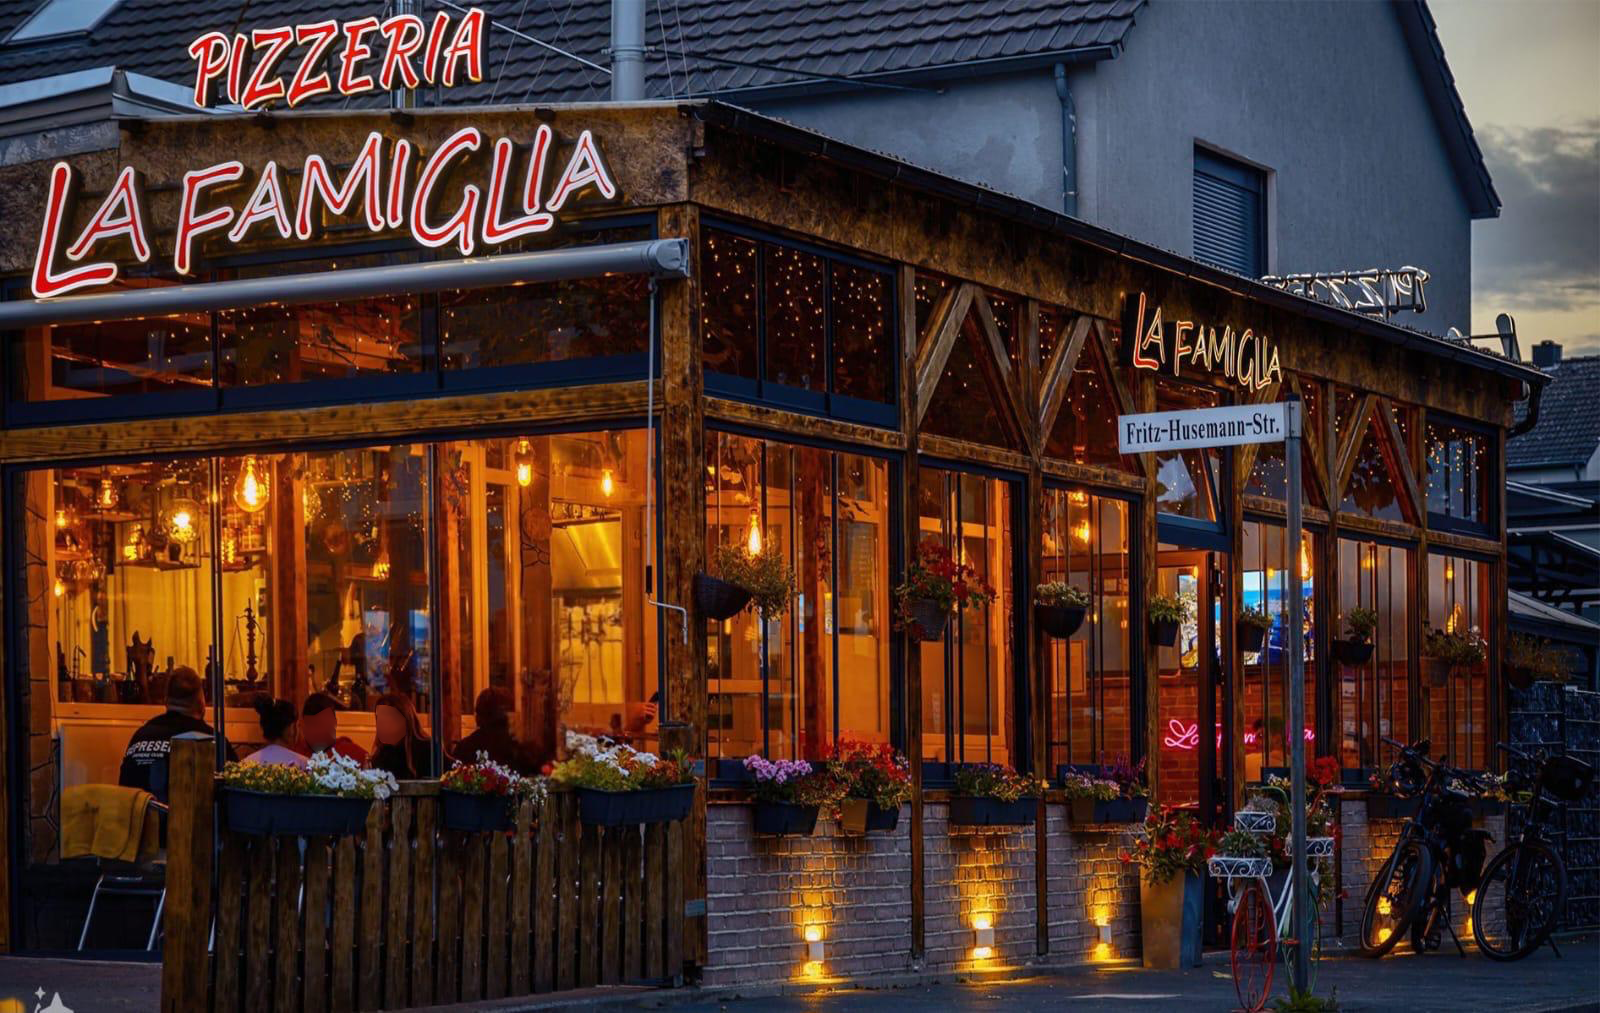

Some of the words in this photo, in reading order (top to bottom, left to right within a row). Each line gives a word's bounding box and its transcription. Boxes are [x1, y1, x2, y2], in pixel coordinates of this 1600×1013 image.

[187, 7, 486, 110] PIZZERIA
[31, 161, 150, 299] LA
[173, 124, 616, 275] FAMIGLIA
[1133, 291, 1166, 371] LA
[1173, 319, 1283, 394] FAMIGLIA
[1126, 412, 1280, 445] Fritz-Husemann-Str.
